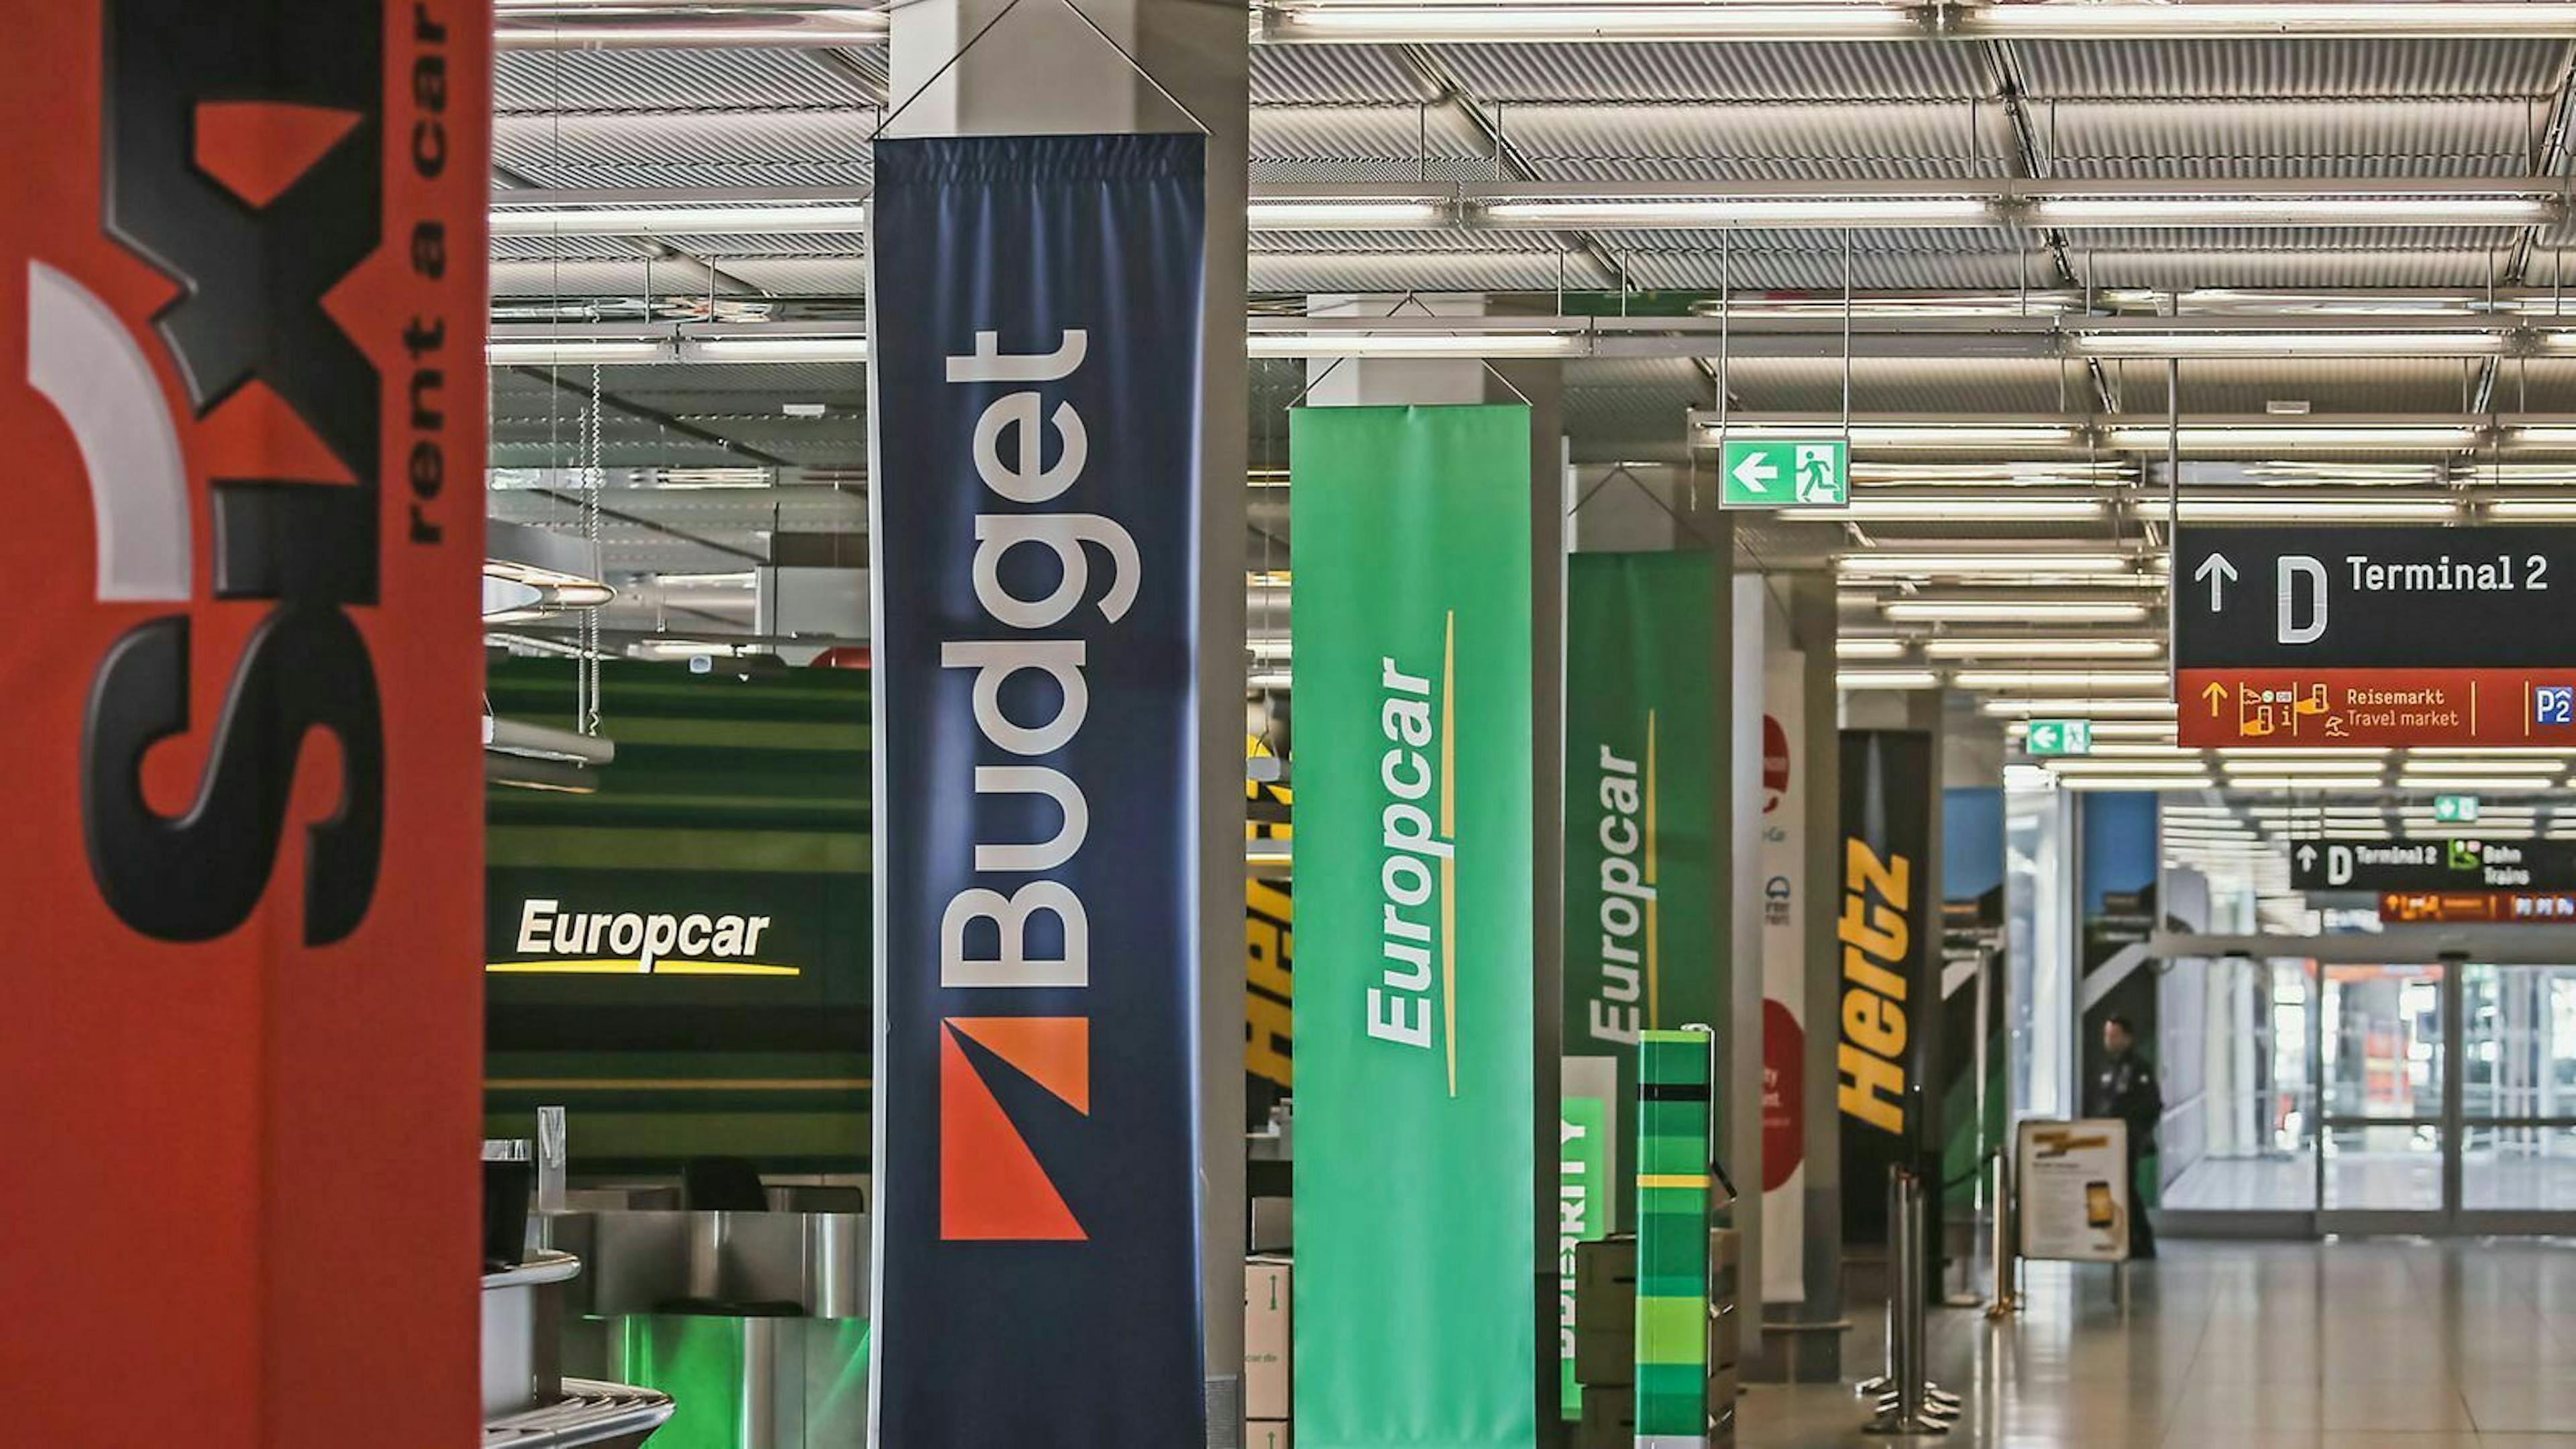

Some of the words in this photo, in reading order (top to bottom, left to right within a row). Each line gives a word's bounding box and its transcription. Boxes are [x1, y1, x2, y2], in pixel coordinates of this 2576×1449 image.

[411, 3, 449, 180] car
[410, 220, 446, 281] a
[405, 315, 446, 546] rent
[941, 329, 1140, 989] Budget
[2277, 555, 2328, 644] D
[2346, 555, 2514, 590] Terminal
[2525, 555, 2548, 590] 2
[2347, 688, 2445, 706] Reisemarkt
[2347, 709, 2396, 727] Travel
[2401, 710, 2459, 727] market
[1367, 656, 1455, 1049] Europcar
[1590, 744, 1657, 1046] Europcar
[2327, 845, 2353, 885] D
[517, 899, 770, 973] Europcar
[1837, 837, 1909, 1135] Hertz
